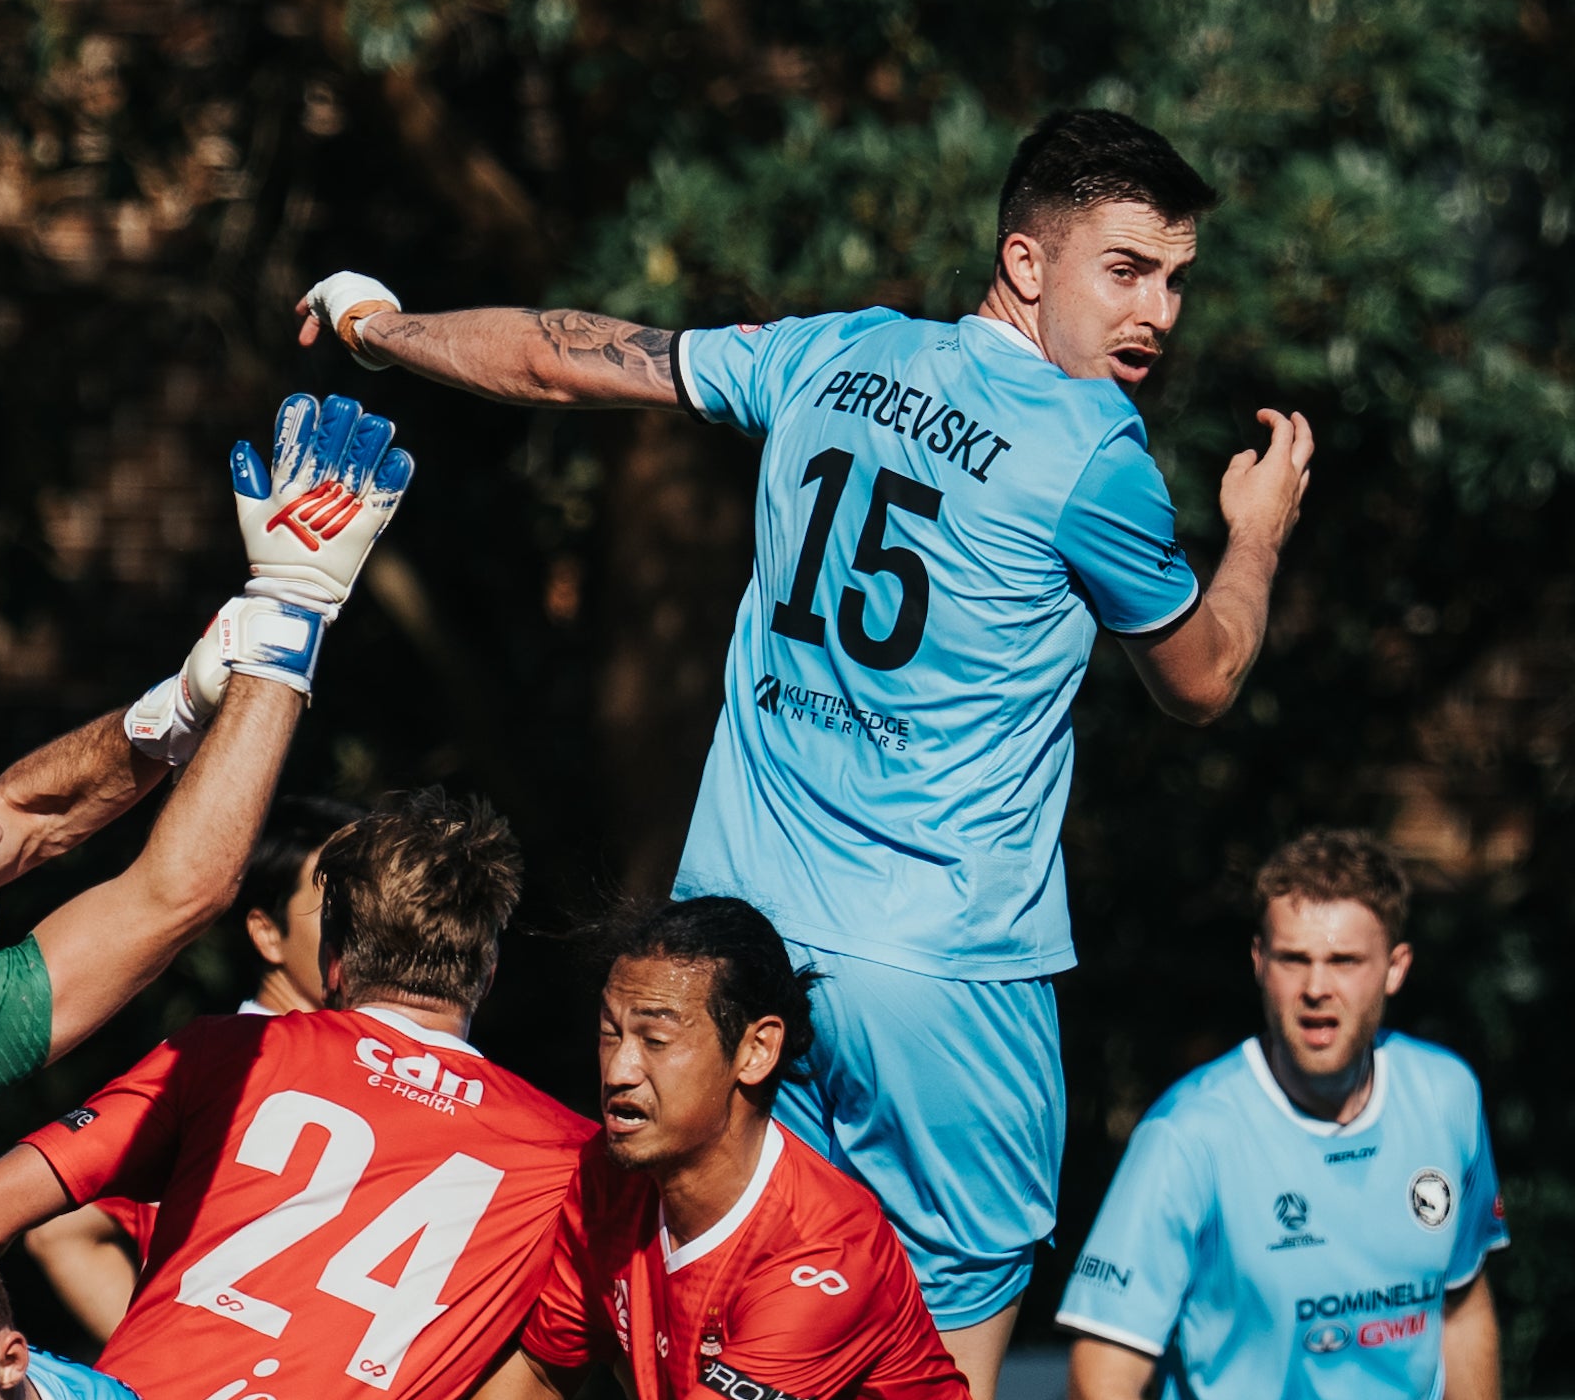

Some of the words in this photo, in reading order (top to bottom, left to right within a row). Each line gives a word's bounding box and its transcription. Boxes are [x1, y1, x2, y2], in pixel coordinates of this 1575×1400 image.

[770, 447, 944, 671] 15
[779, 704, 908, 751] INTERIORS
[784, 684, 861, 720] KUTTIN
[354, 1037, 484, 1105] cdn
[367, 1073, 456, 1117] e-Health
[174, 1089, 505, 1391] 24
